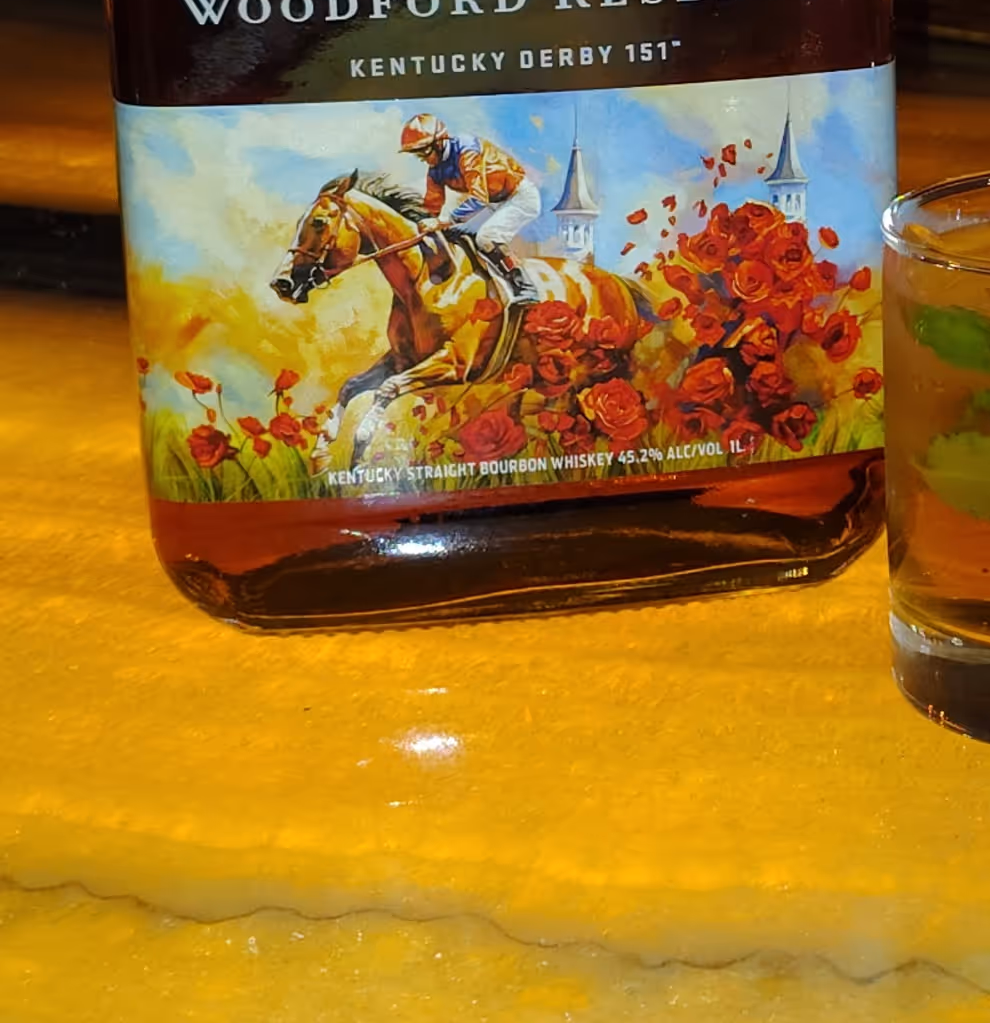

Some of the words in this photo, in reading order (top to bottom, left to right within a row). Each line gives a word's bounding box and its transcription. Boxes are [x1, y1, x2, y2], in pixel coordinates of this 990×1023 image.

[350, 51, 506, 78] KENTUCKY
[519, 44, 613, 69] DERBY
[328, 466, 406, 486] KENTUCKY
[406, 461, 477, 481] STRAIGHT
[479, 456, 548, 475] BOURBON
[551, 451, 614, 470] WHISKEY
[617, 447, 664, 465] 45.2%
[666, 440, 724, 460] ALC/VOL
[729, 439, 746, 454] 1L
